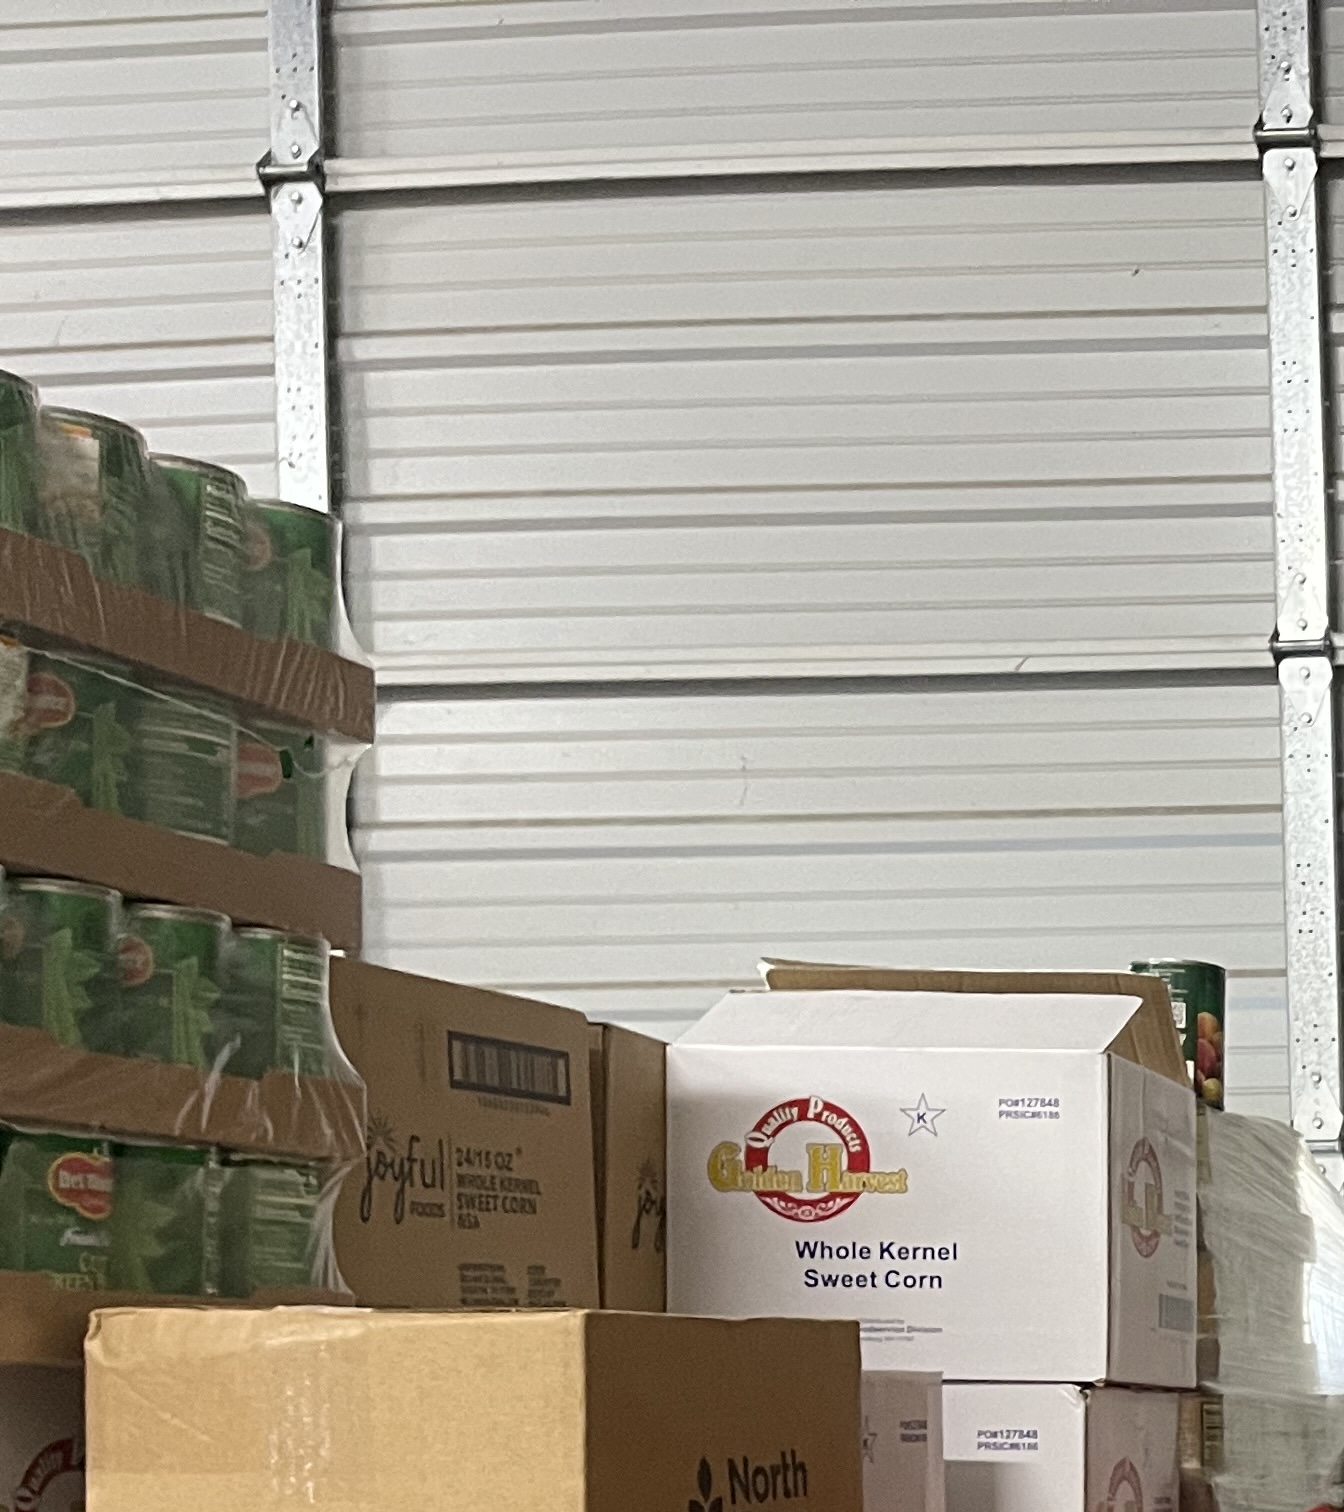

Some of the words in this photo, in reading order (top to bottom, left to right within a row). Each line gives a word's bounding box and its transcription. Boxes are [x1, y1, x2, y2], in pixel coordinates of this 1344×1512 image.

[743, 1104, 799, 1149] Quality
[806, 1095, 862, 1155] Products
[916, 1112, 928, 1124] K
[360, 1133, 446, 1226] joyful
[707, 1141, 804, 1195] Golden
[806, 1142, 910, 1195] Harvest
[456, 1192, 499, 1213] SWEET
[501, 1195, 538, 1215] CORN
[795, 1240, 872, 1261] Whole
[878, 1240, 959, 1262] Kernel
[803, 1269, 878, 1289] Sweet
[884, 1269, 943, 1290] Corn
[727, 1448, 808, 1506] North
